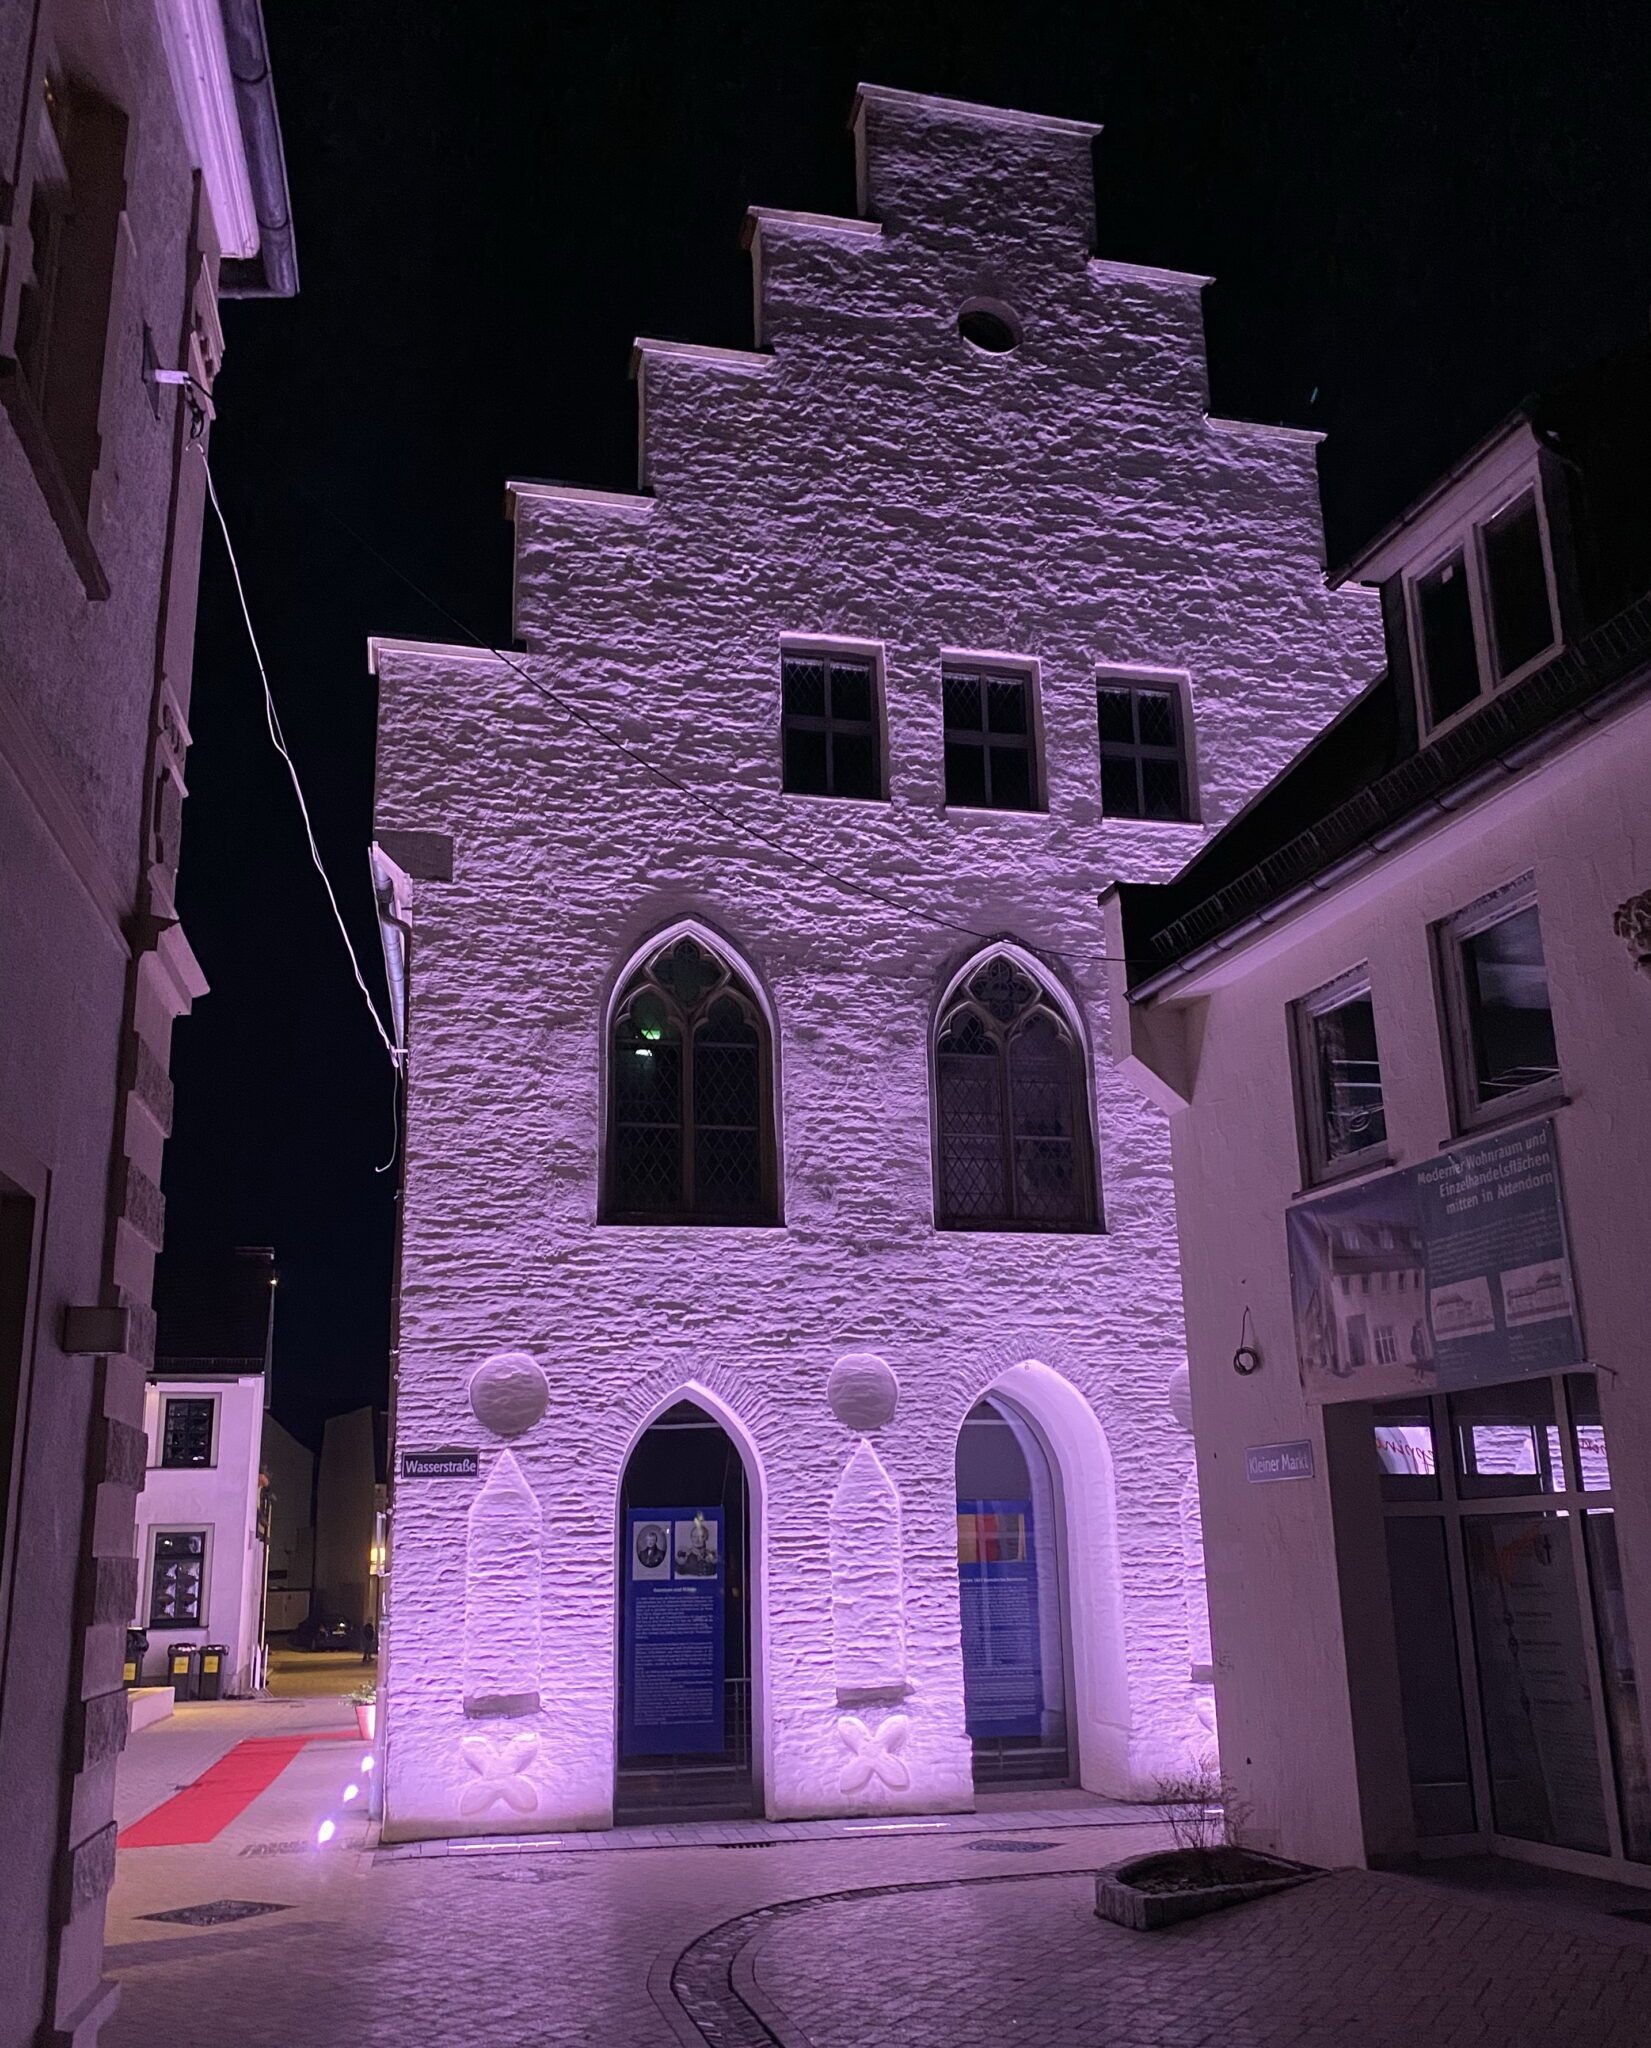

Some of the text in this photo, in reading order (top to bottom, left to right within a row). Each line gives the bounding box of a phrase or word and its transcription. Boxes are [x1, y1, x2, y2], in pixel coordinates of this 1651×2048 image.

[1417, 1130, 1547, 1185] Moderner Wohnraum und
[1439, 1152, 1550, 1198] Einzelhandelsflächen
[1446, 1171, 1553, 1215] mitten in Attendorn
[405, 1458, 476, 1473] Wasserstraße
[1248, 1453, 1309, 1473] Kleiner Markt
